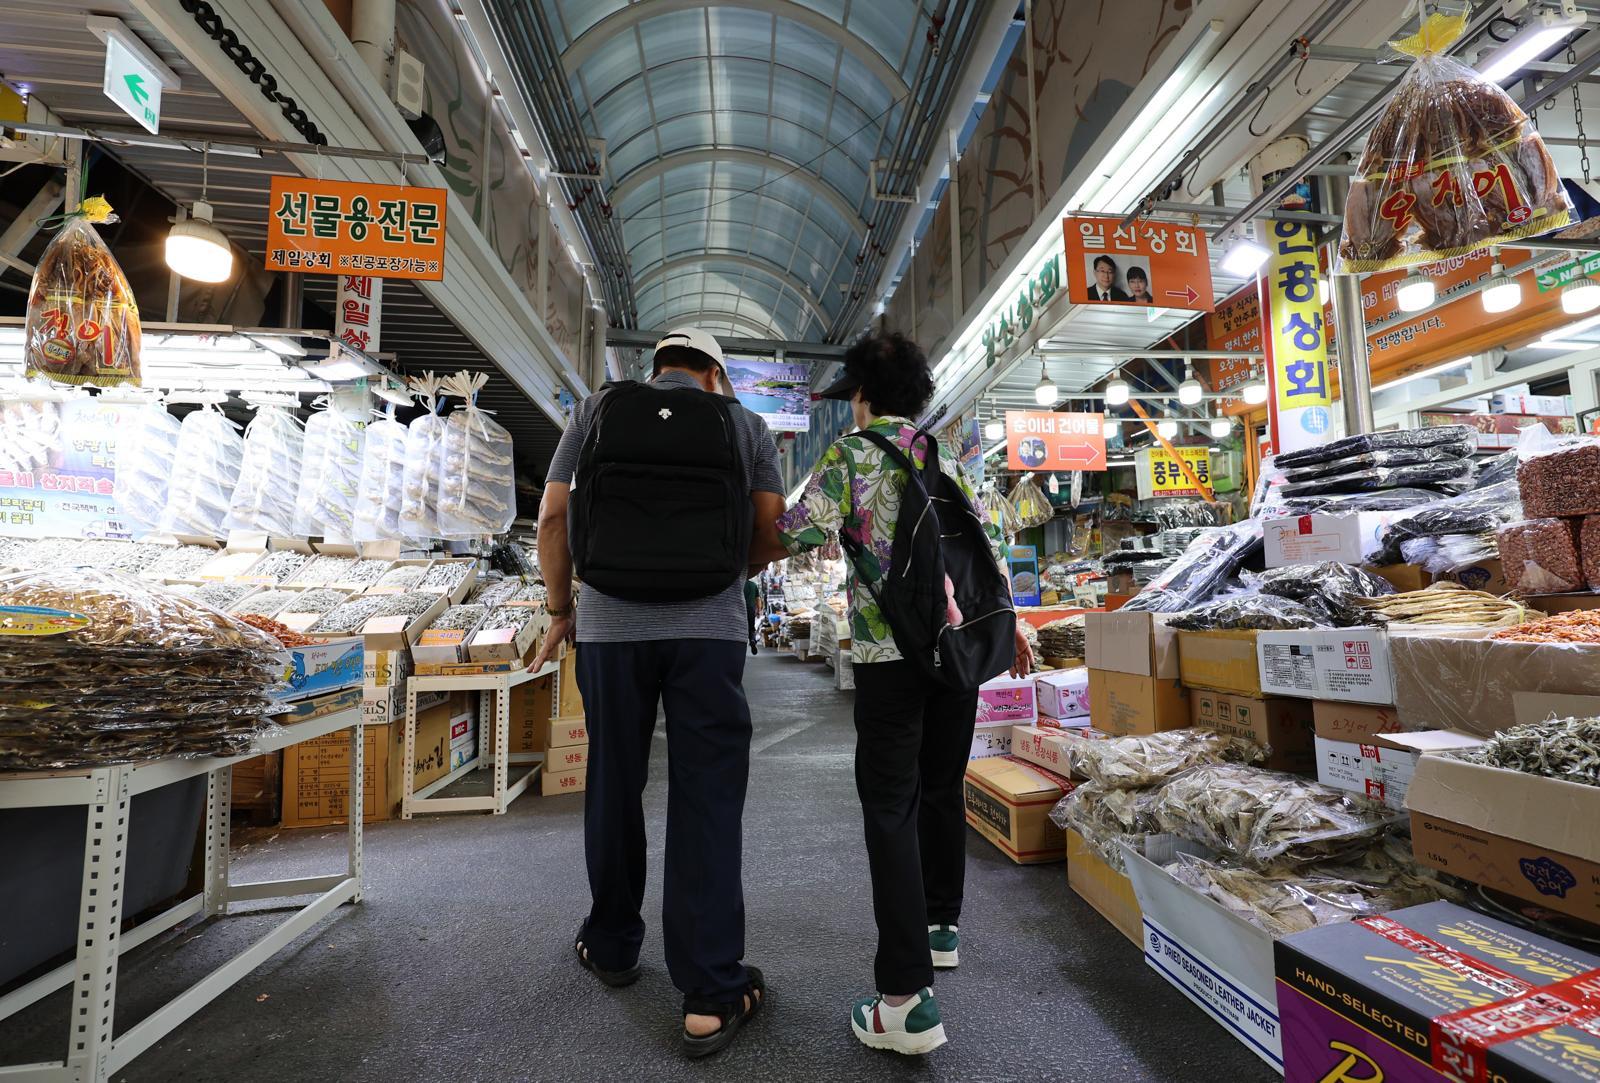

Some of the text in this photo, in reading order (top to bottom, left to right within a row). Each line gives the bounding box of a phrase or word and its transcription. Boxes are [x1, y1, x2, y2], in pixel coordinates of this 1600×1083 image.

[275, 191, 439, 246] 선물용전문
[1079, 221, 1198, 257] 일신상회
[272, 249, 332, 268] 제일상회
[1376, 316, 1445, 349] 발행합니다.
[1014, 416, 1099, 435] 순이네 건어물
[1153, 459, 1209, 486] 중부유통
[568, 728, 585, 739] 냉동
[565, 753, 582, 763] 냉동
[559, 776, 576, 787] 냉동
[1164, 944, 1276, 1038] DRIED SEASONED LEATHER JACKET
[1382, 966, 1467, 1009] California
[1295, 967, 1429, 1048] HAND-SELECTED
